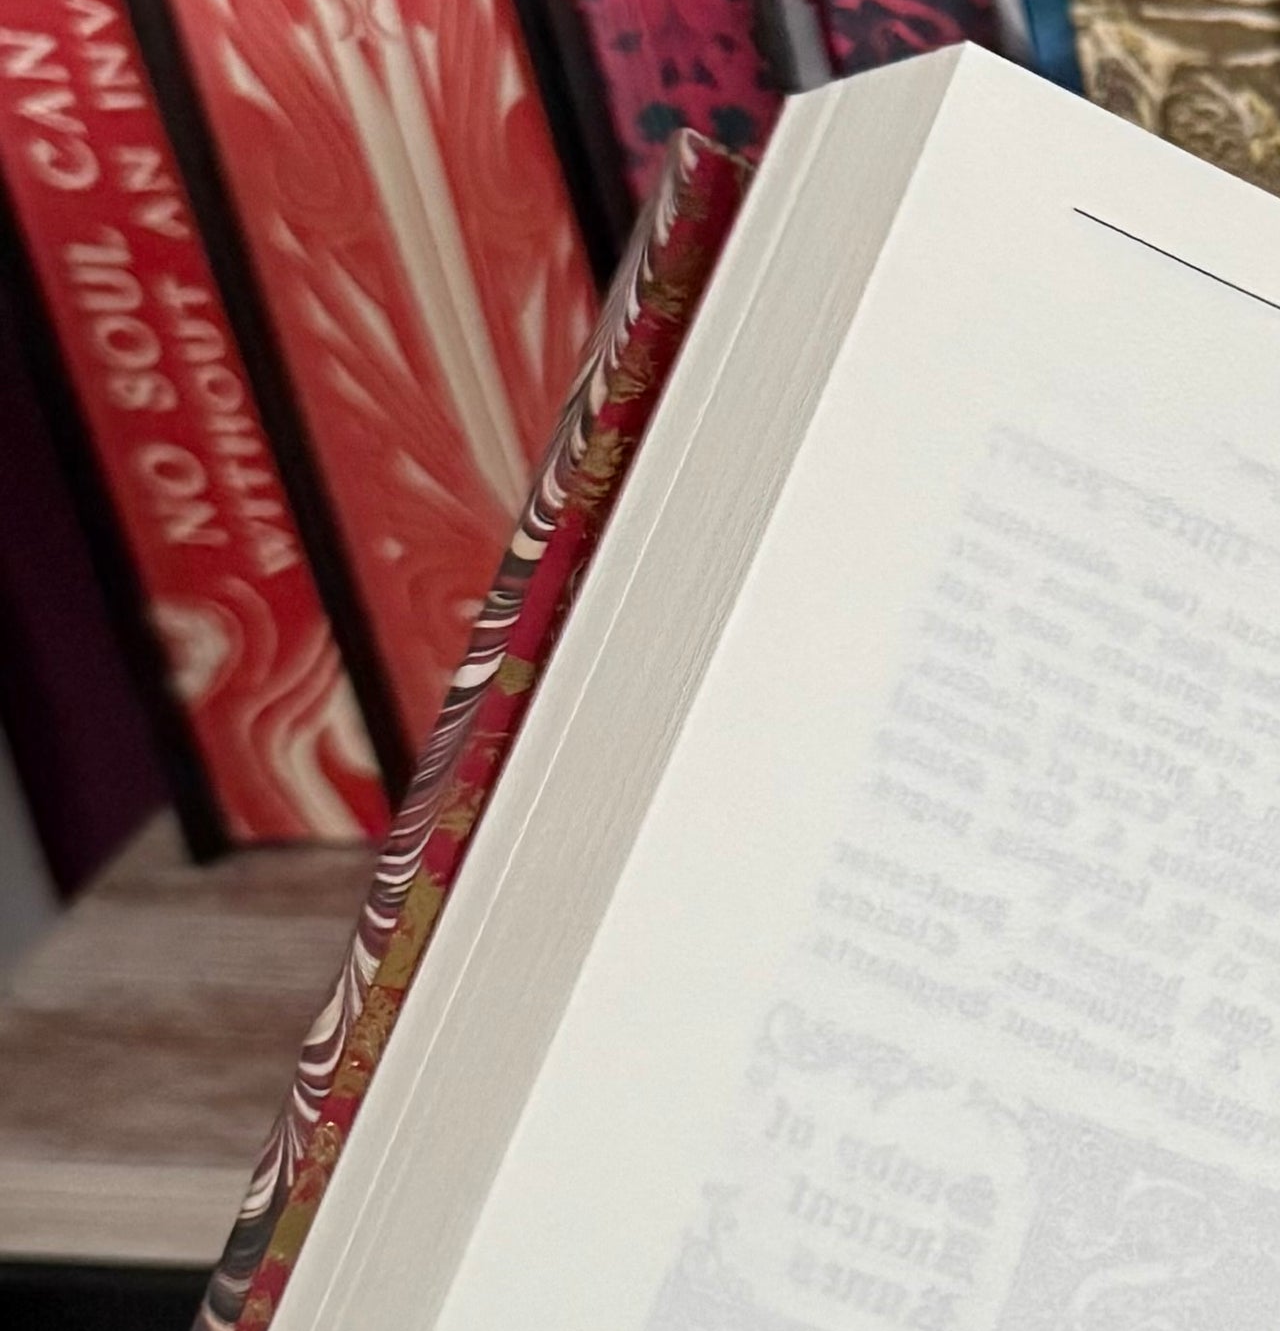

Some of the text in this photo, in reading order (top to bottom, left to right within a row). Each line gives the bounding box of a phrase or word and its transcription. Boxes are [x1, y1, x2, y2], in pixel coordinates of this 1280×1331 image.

[0, 26, 231, 547] NO SOUL CAN
[115, 146, 192, 239] AN
[154, 267, 300, 576] WITHOUT
